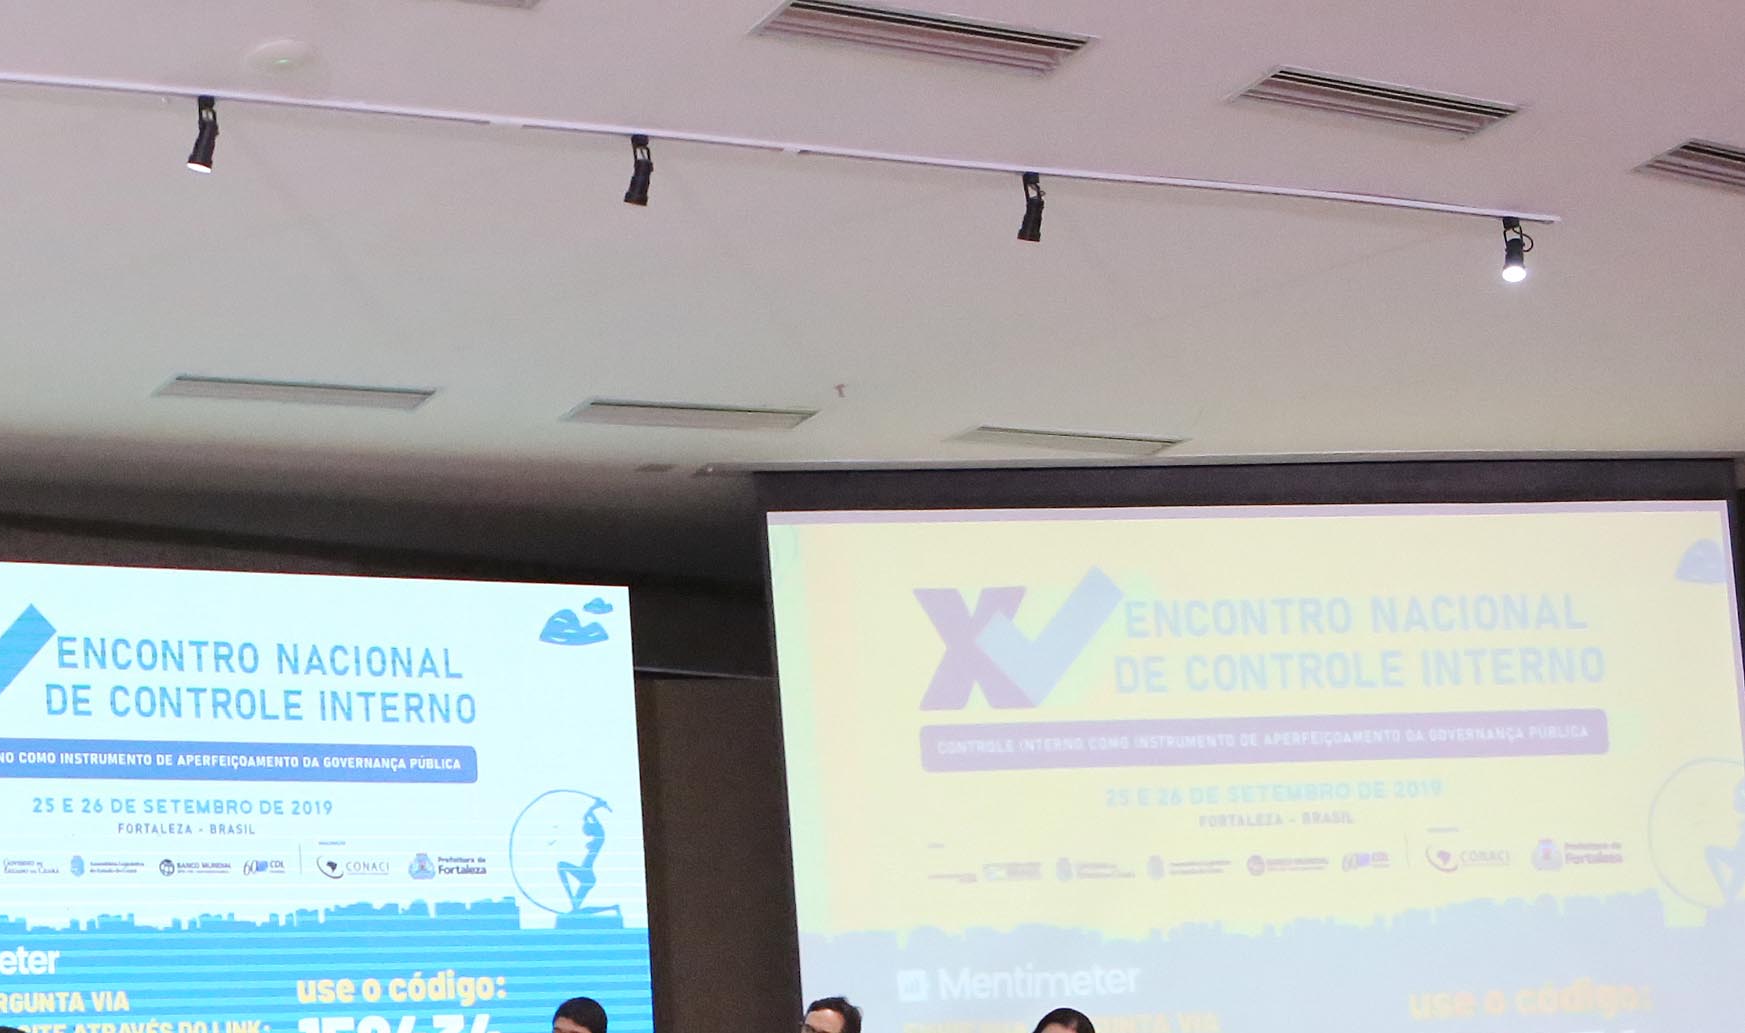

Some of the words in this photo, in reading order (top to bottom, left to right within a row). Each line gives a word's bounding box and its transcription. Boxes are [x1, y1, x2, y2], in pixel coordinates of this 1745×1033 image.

[1125, 596, 1352, 638] ENCONTRO
[1371, 593, 1588, 633] NACIONAL
[57, 636, 259, 673] ENCONTRO
[277, 643, 464, 679] NACIONAL
[1115, 655, 1168, 693] DE
[1186, 650, 1405, 691] CONTROLE
[1422, 646, 1606, 686] INTERNO
[46, 684, 92, 717] DE
[110, 685, 303, 721] CONTROLE
[320, 691, 477, 725] INTERNO
[938, 737, 1014, 754] CONTROLE
[1019, 736, 1083, 752] INTERNO
[1088, 735, 1129, 750] COMO
[1134, 733, 1234, 750] INSTRUMENTO
[1240, 733, 1258, 748] DE
[1264, 729, 1400, 749] APERFEIÇOAMENTO
[1406, 728, 1423, 743] DA
[1429, 726, 1524, 744] GOVERNANÇA
[18, 752, 57, 766] COMO
[60, 752, 153, 767] INSTRUMENTO
[156, 754, 173, 767] DE
[177, 753, 300, 771] APERFEIÇOAMENTO
[302, 755, 321, 769] DA
[323, 755, 407, 772] GOVERNANÇA
[409, 754, 462, 770] PÚBLICA
[1106, 788, 1129, 806] 25
[1138, 788, 1150, 806] E
[1159, 787, 1182, 805] 26
[1190, 785, 1219, 805] DE
[1228, 782, 1351, 804] SETEMBRO
[1359, 781, 1385, 800] DE
[1394, 779, 1442, 799] 2019
[32, 798, 55, 813] 25
[63, 798, 73, 813] E
[81, 798, 103, 814] 26
[111, 798, 136, 814] DE
[143, 798, 253, 815] SETEMBRO
[259, 800, 284, 815] DE
[291, 800, 333, 815] 2019
[1199, 813, 1283, 828] FORTALEZA
[1303, 810, 1353, 826] BRASIL
[118, 823, 192, 835] FORTALEZA
[210, 823, 255, 835] BRASIL
[346, 861, 390, 872] CONACI
[438, 865, 487, 875] Fortaleza
[297, 977, 354, 1004] use
[362, 977, 381, 1002] o
[387, 970, 507, 1007] código:
[937, 963, 1141, 1000] Mentimeter
[90, 991, 129, 1012] VIA
[1410, 990, 1476, 1021] use
[1484, 989, 1505, 1015] o
[1516, 976, 1653, 1020] código:
